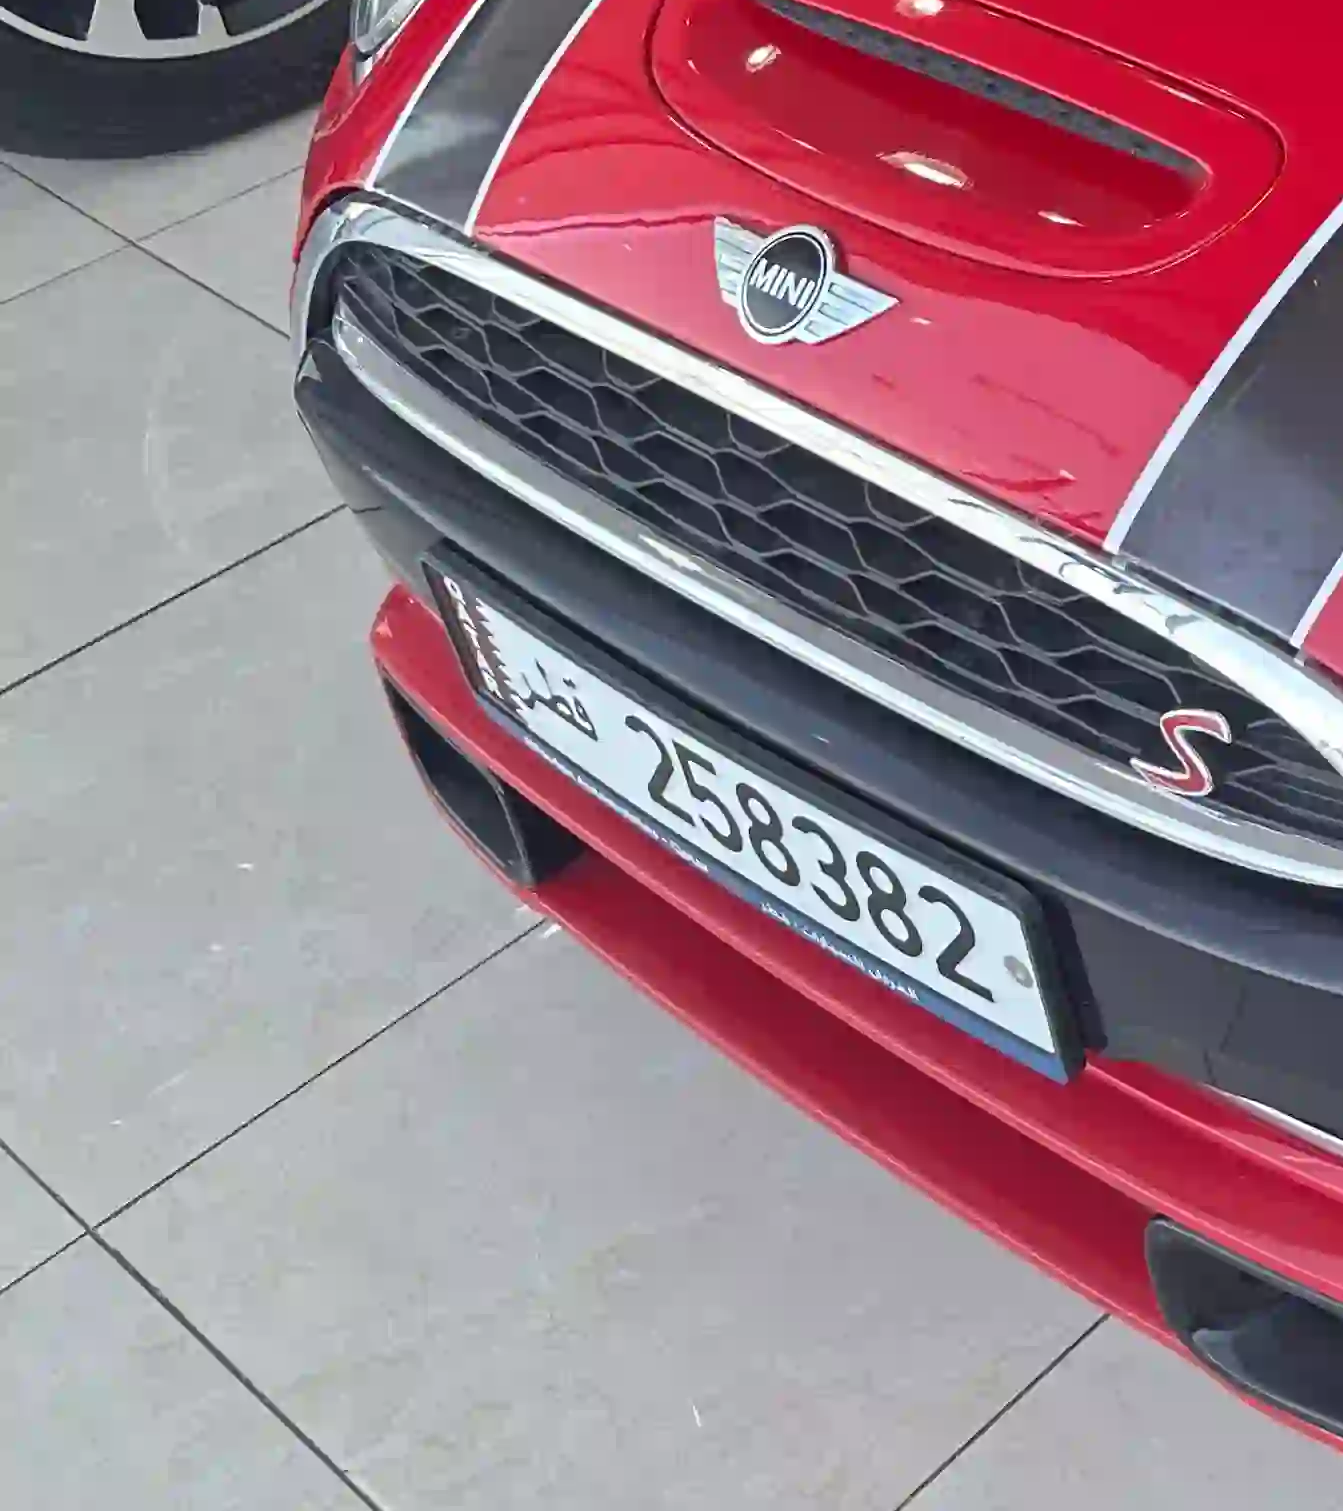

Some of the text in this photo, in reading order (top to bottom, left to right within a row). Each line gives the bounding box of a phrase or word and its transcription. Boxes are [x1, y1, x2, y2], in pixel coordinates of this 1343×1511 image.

[750, 257, 816, 310] MINI
[518, 656, 599, 742] قطر
[1129, 708, 1232, 797] S
[624, 714, 997, 1004] 258382
